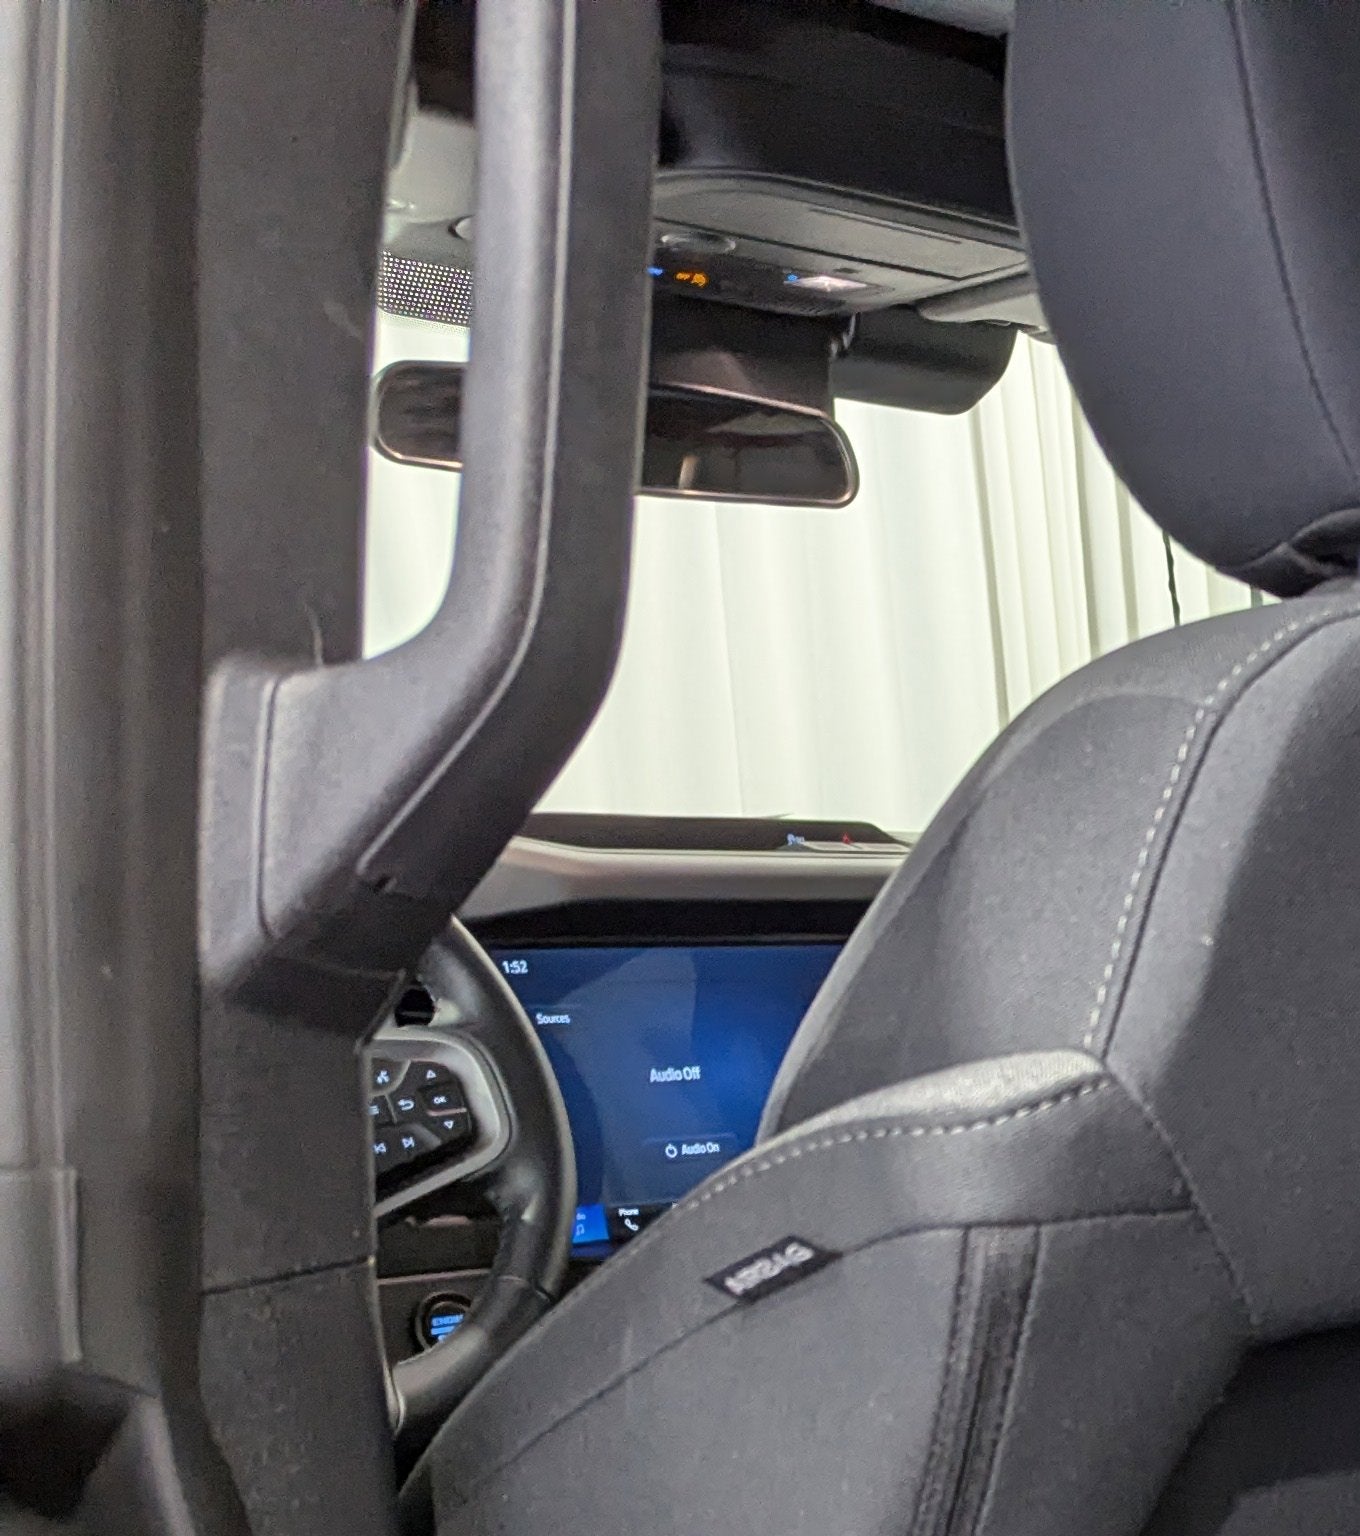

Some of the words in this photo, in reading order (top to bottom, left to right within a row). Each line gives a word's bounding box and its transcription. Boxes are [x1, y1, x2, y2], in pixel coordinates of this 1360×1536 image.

[502, 959, 529, 975] 1:52
[535, 1012, 571, 1025] Sources
[649, 1067, 683, 1083] Audio
[682, 1065, 701, 1081] Off
[681, 1143, 706, 1155] Audio
[706, 1141, 721, 1154] On
